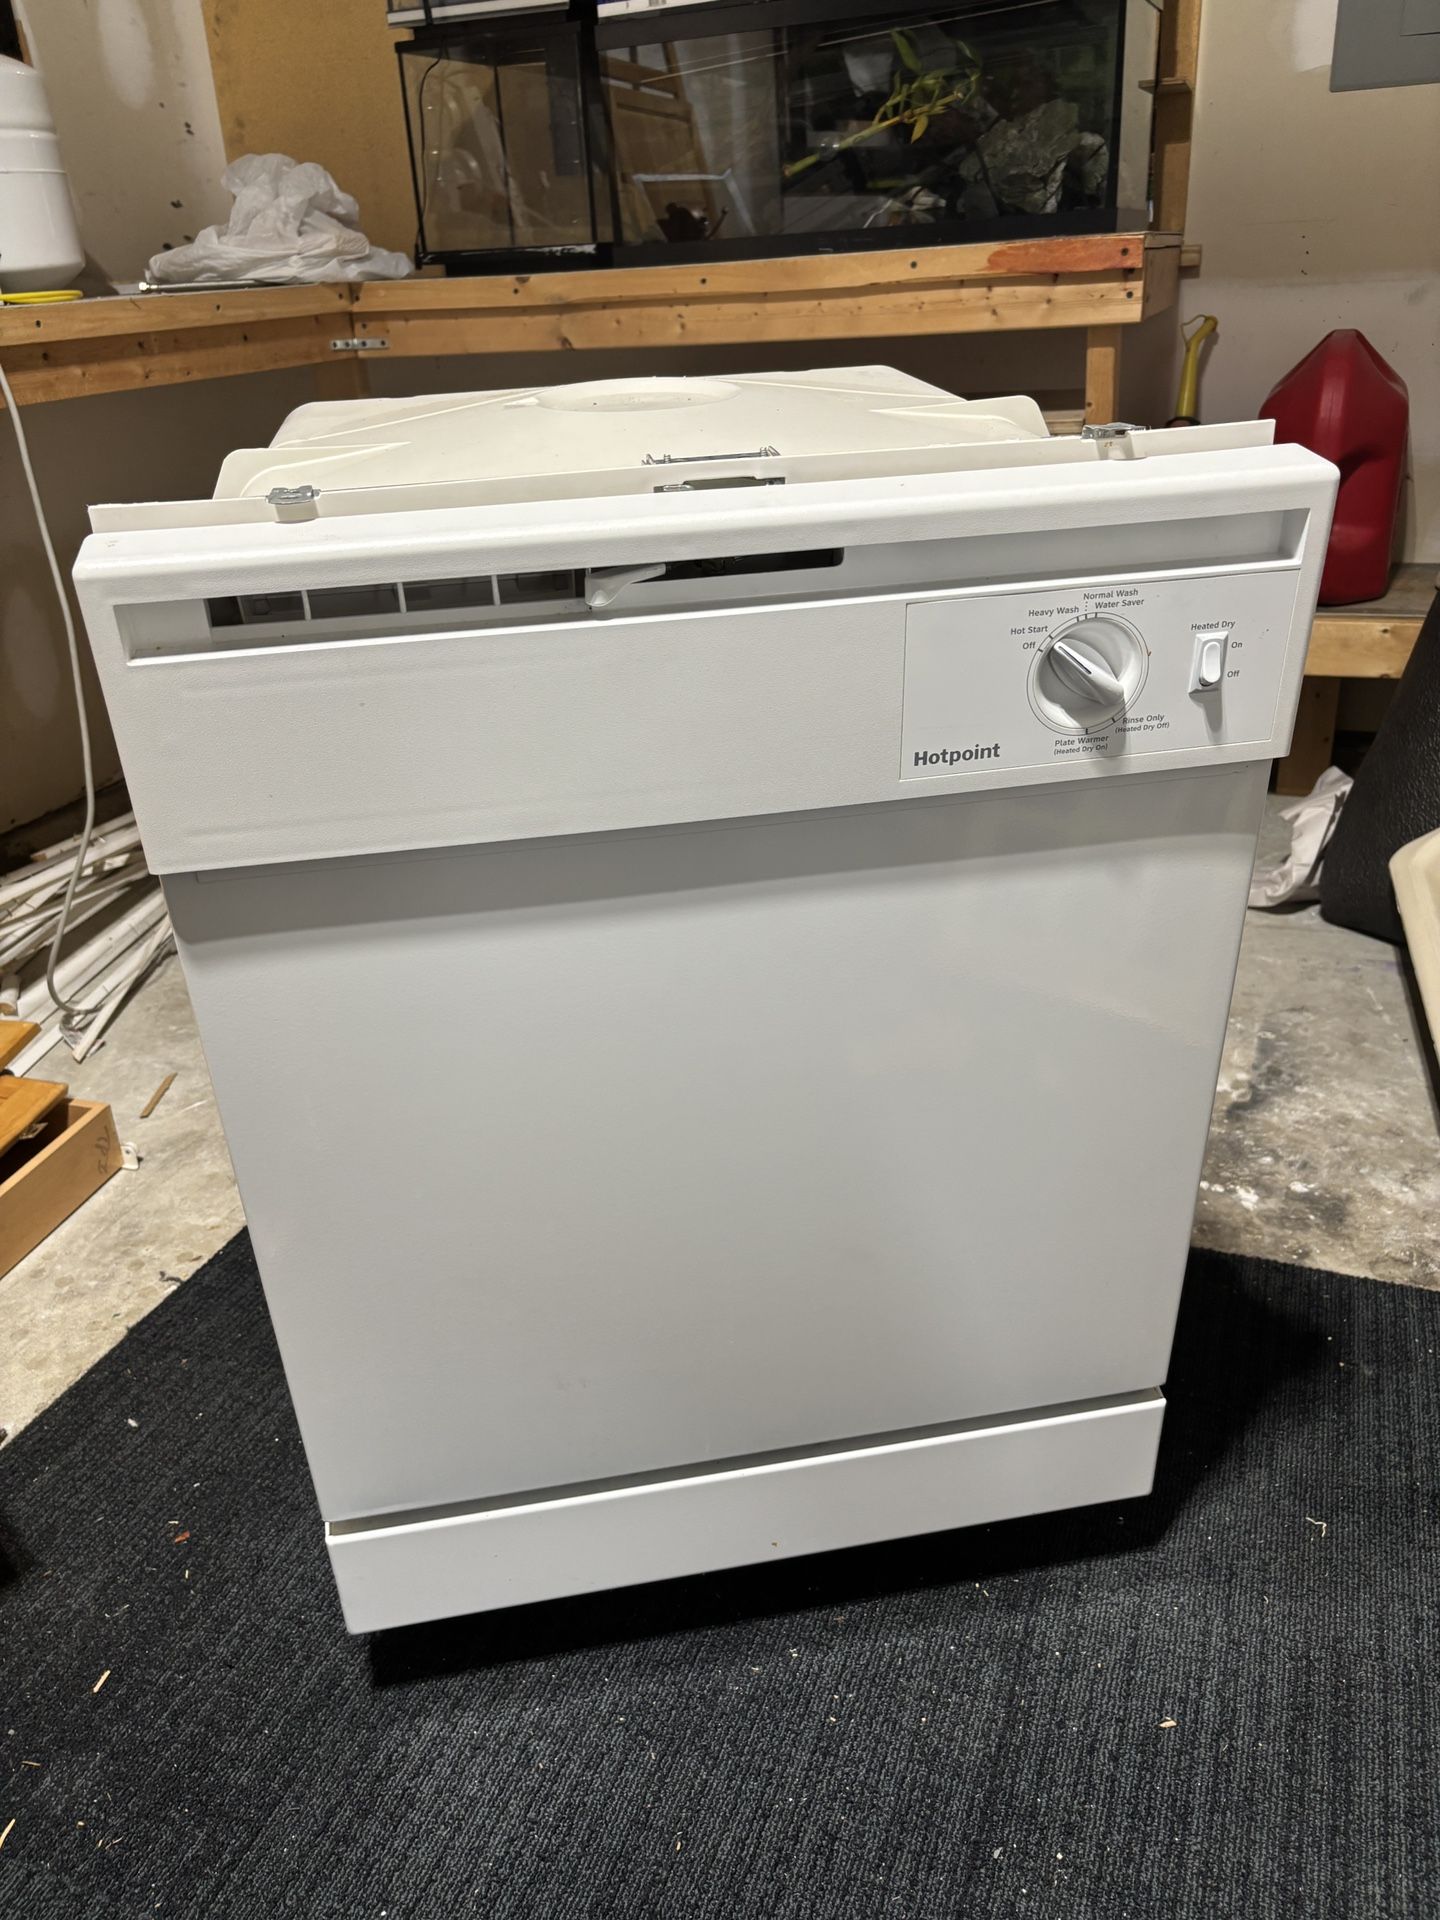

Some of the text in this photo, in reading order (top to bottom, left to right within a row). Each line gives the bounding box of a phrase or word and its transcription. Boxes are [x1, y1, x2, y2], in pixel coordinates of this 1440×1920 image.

[1083, 588, 1139, 600] Normal Wash
[1095, 599, 1145, 609] Water Saver
[1028, 606, 1080, 617] Heavy Wash
[1010, 625, 1048, 635] Hot Start
[1190, 620, 1236, 631] Heated Dry
[1023, 642, 1036, 650] Off
[1231, 641, 1243, 649] On
[1227, 670, 1240, 678] Off
[1122, 713, 1165, 724] Rinse Only
[1114, 721, 1170, 734] (Heated Dry Off)
[1054, 735, 1109, 747] Plate Warmer
[914, 743, 1001, 766] Hotpoint
[1053, 743, 1108, 756] (Heated Dry On)
